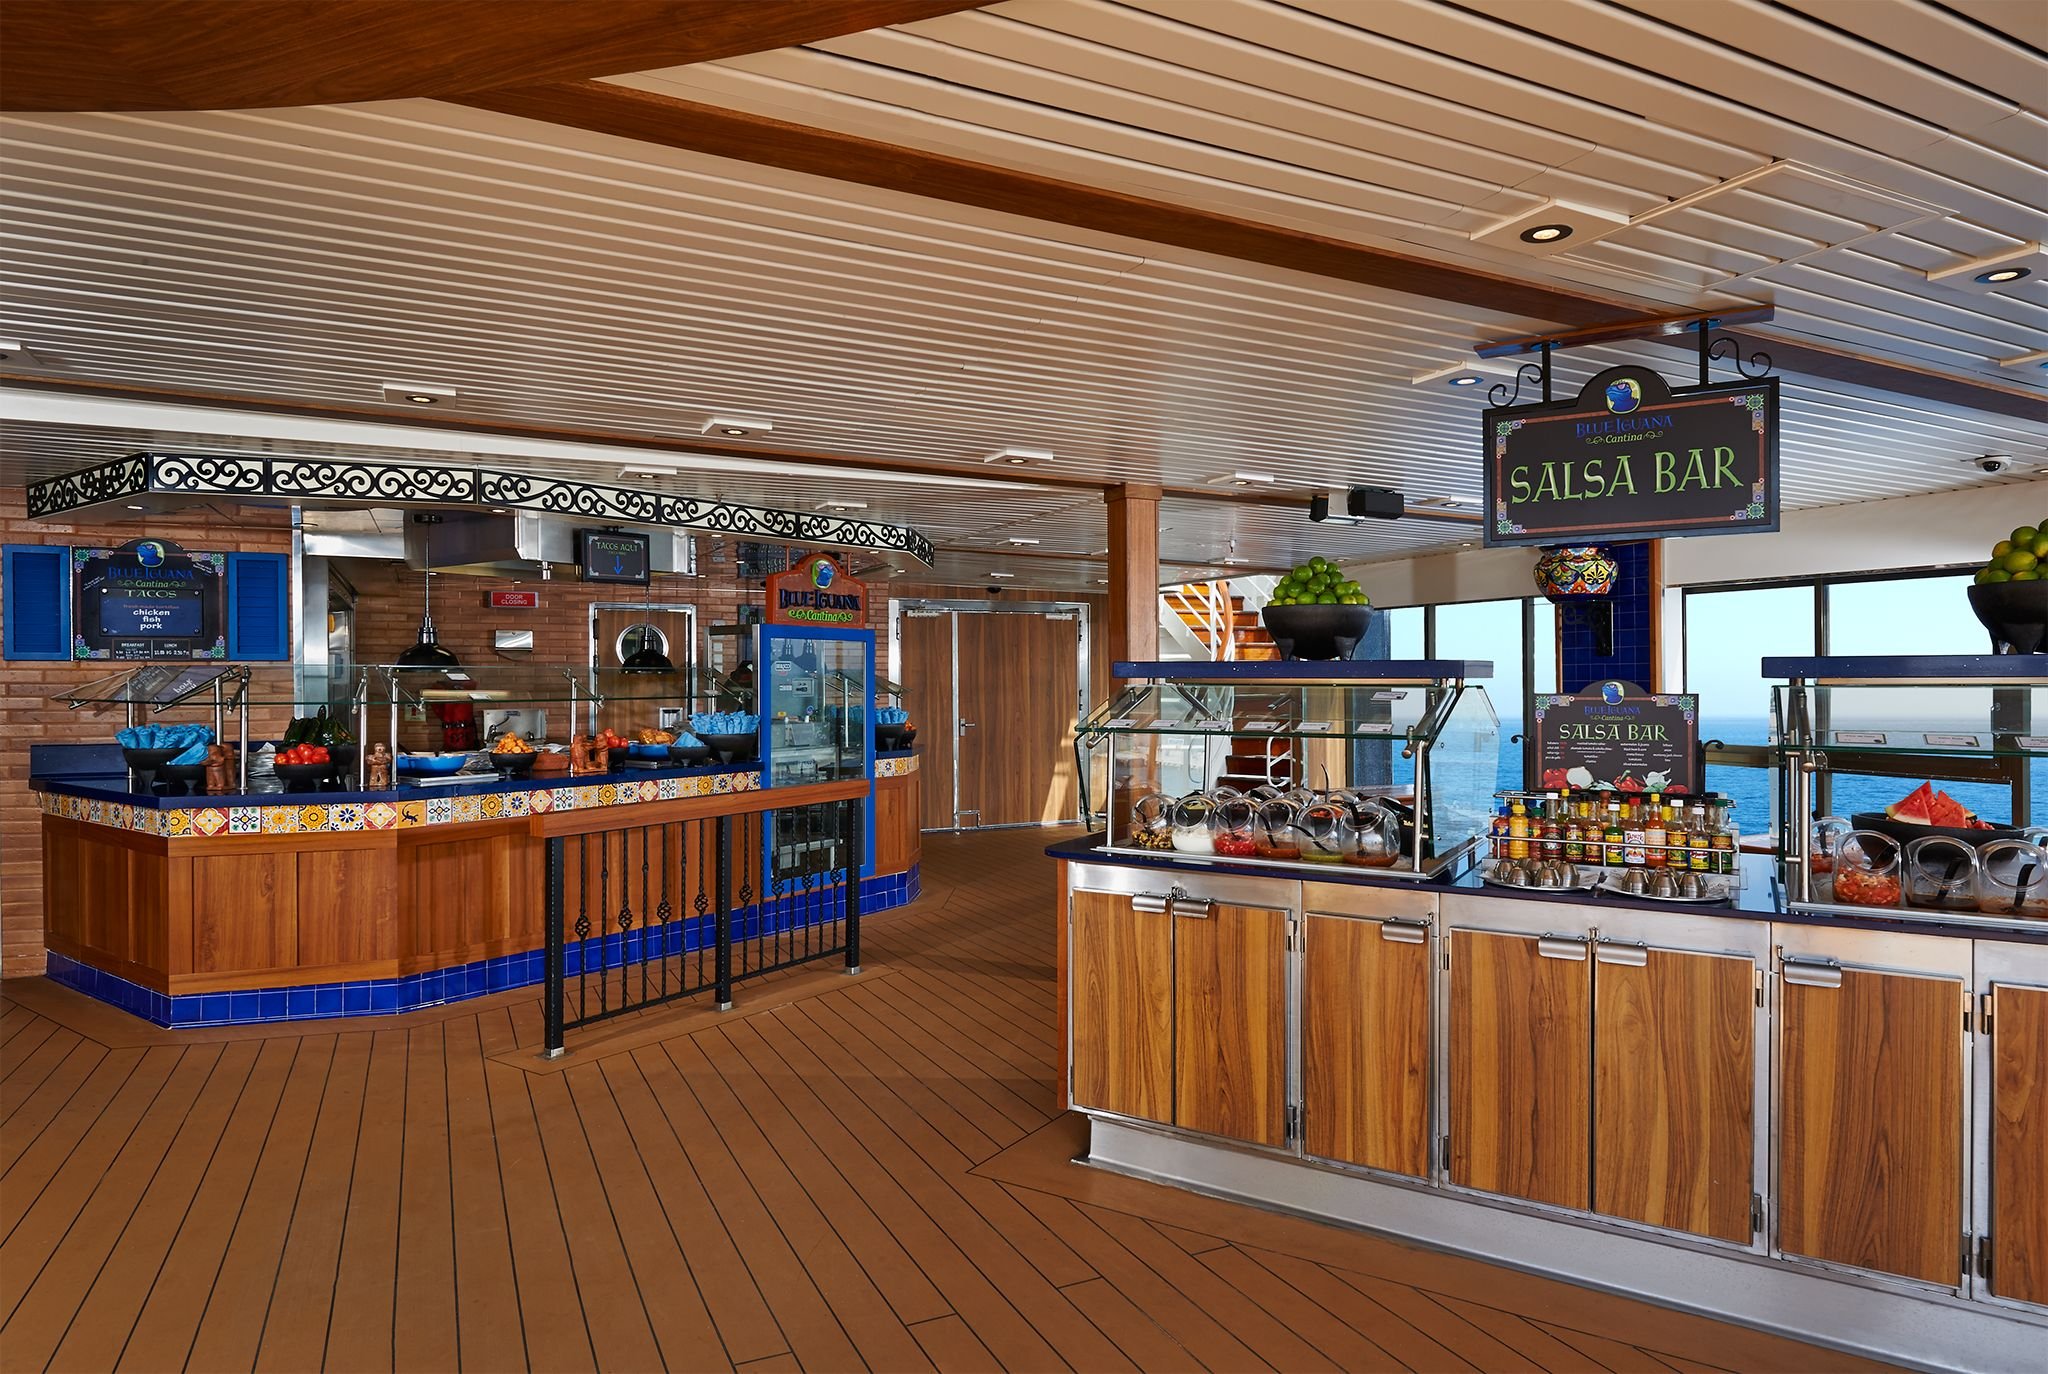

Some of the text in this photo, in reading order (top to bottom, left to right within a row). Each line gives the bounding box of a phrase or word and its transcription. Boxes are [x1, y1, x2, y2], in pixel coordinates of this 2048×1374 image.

[1576, 415, 1673, 438] BLUE IGUANA
[1605, 433, 1643, 444] Cantina
[1510, 446, 1744, 505] SALSA BAR
[596, 541, 619, 550] TACOS
[108, 567, 140, 580] BLUE
[144, 567, 194, 580] IGUANA
[135, 580, 169, 588] Cantina
[125, 589, 177, 598] TACOS
[779, 588, 861, 611] BLUE IGUANA
[806, 610, 838, 622] Cantina
[140, 623, 163, 631] pork
[1584, 705, 1641, 716] BLUE IGUANA
[1559, 723, 1669, 741] SALSA BAR
